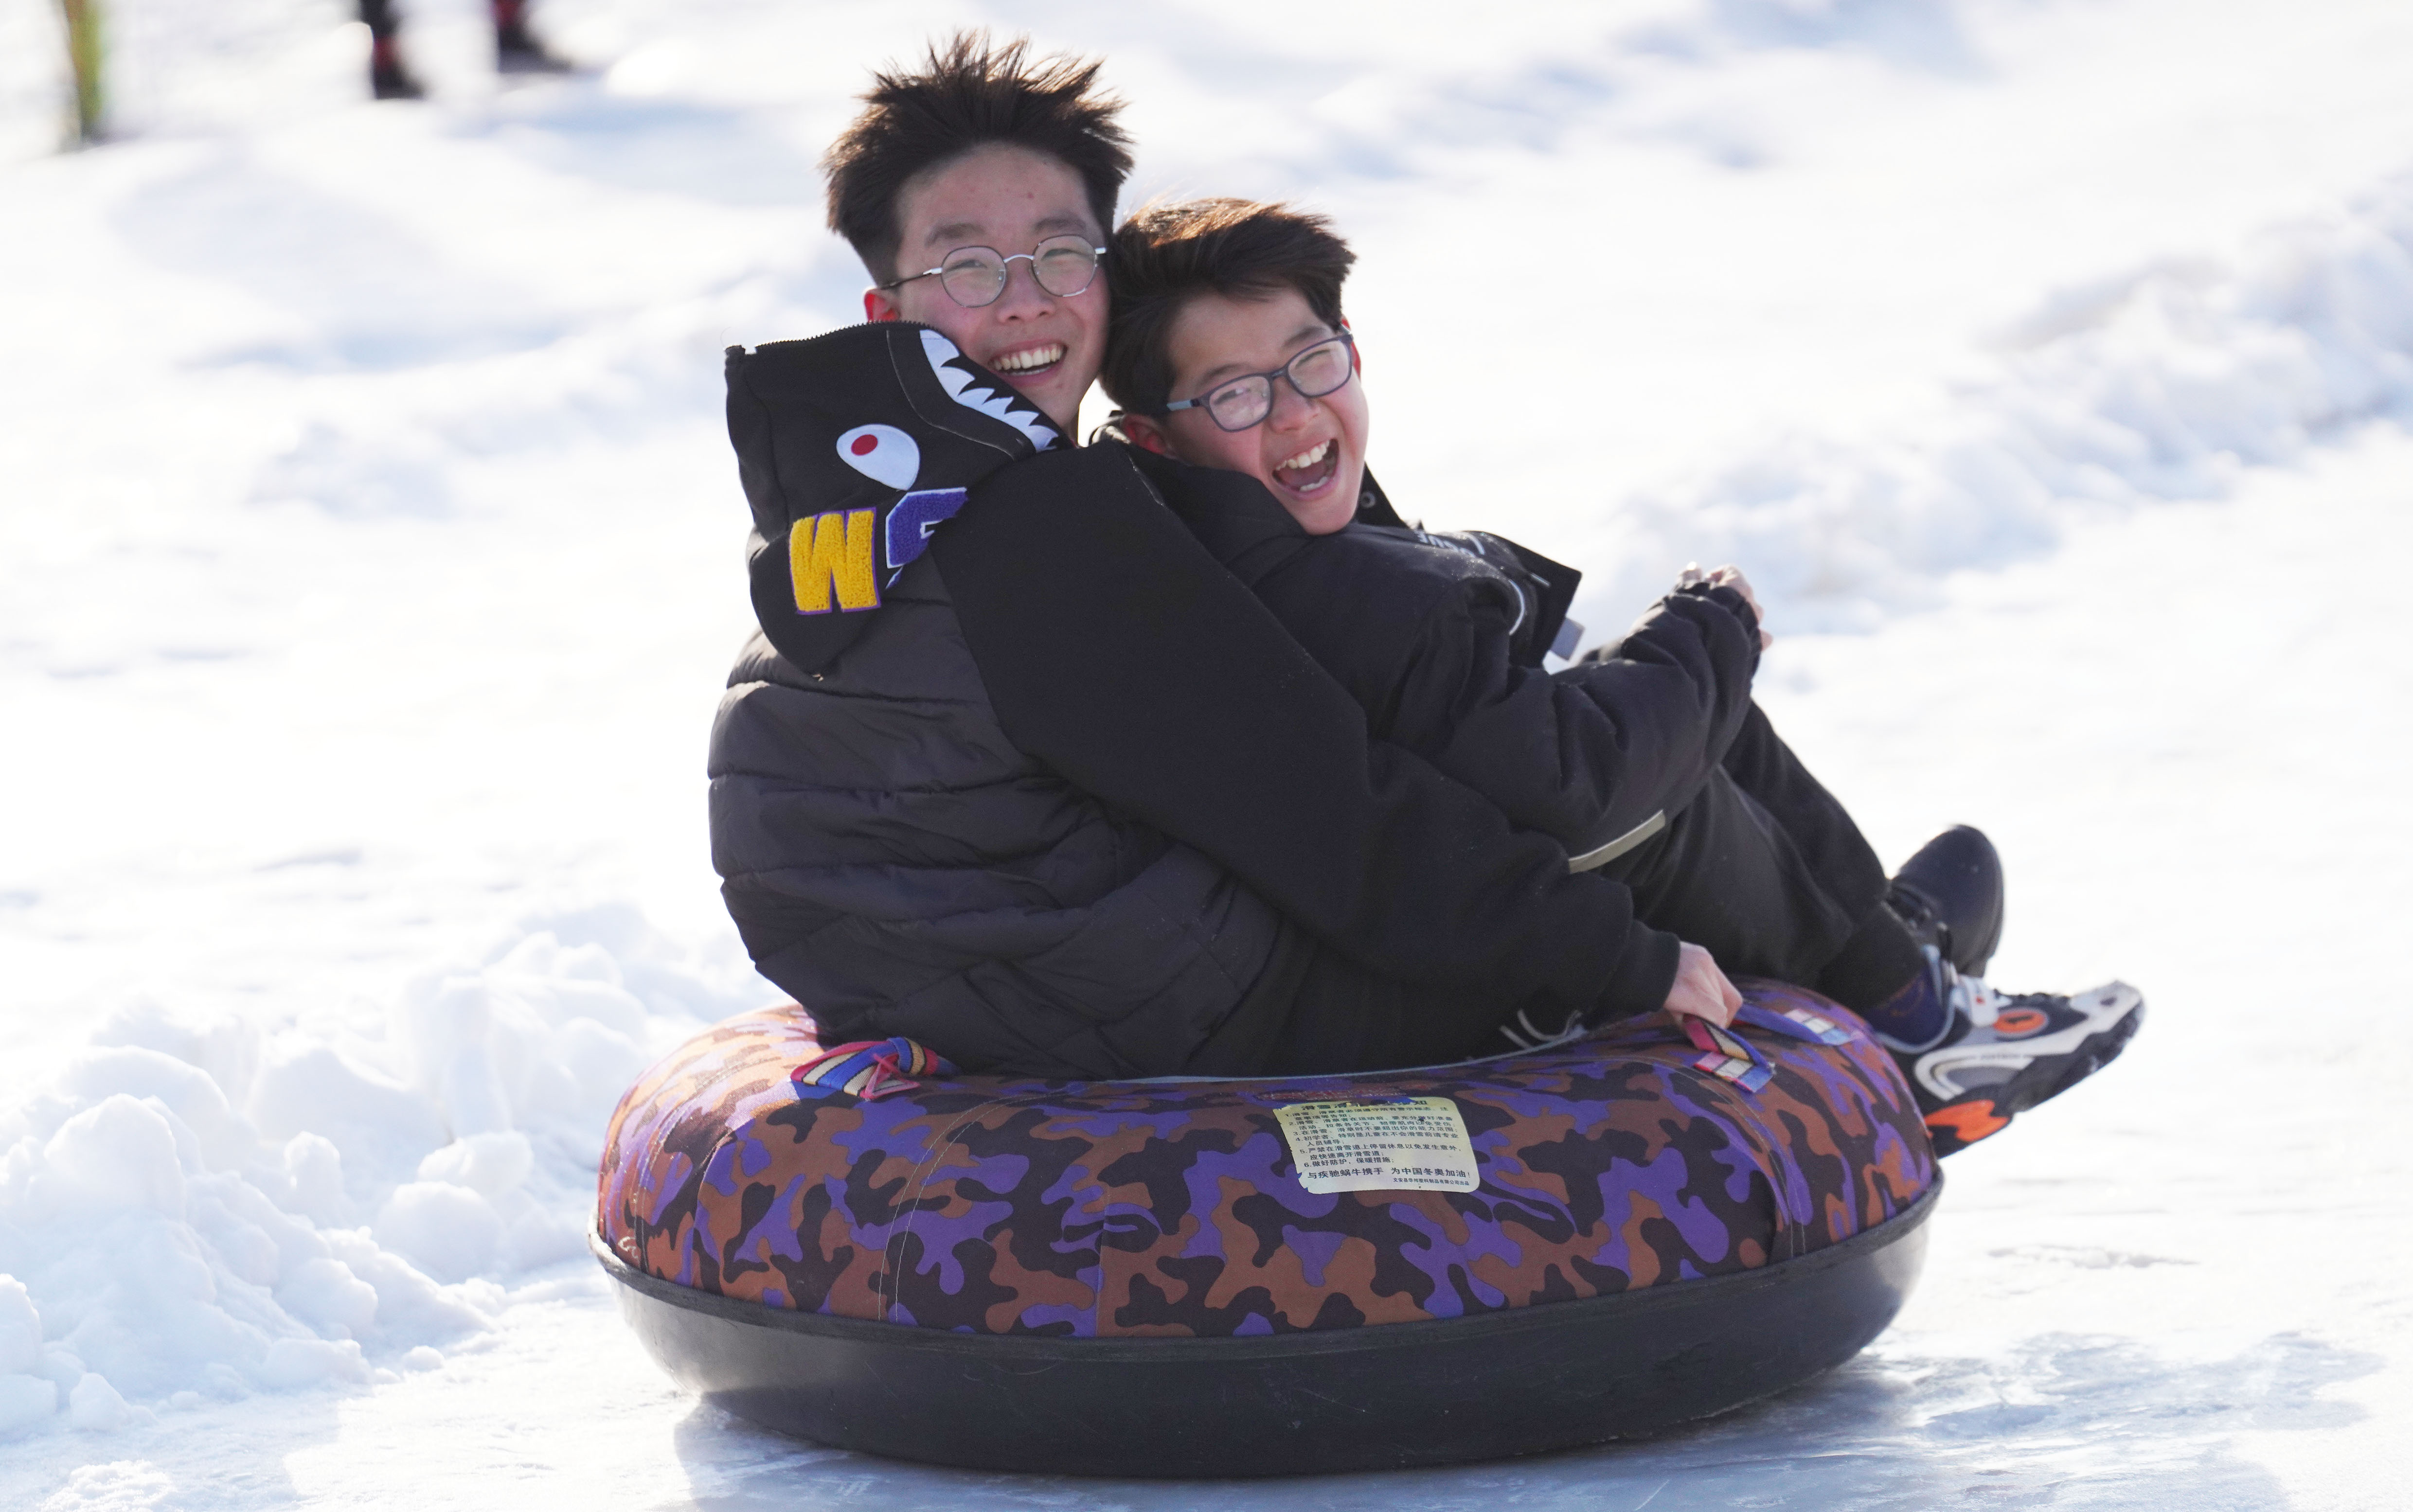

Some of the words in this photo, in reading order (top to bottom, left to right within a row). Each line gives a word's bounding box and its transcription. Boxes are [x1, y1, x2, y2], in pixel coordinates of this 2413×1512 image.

[1307, 1167, 1384, 1179] 与疾驰蜗牛携手
